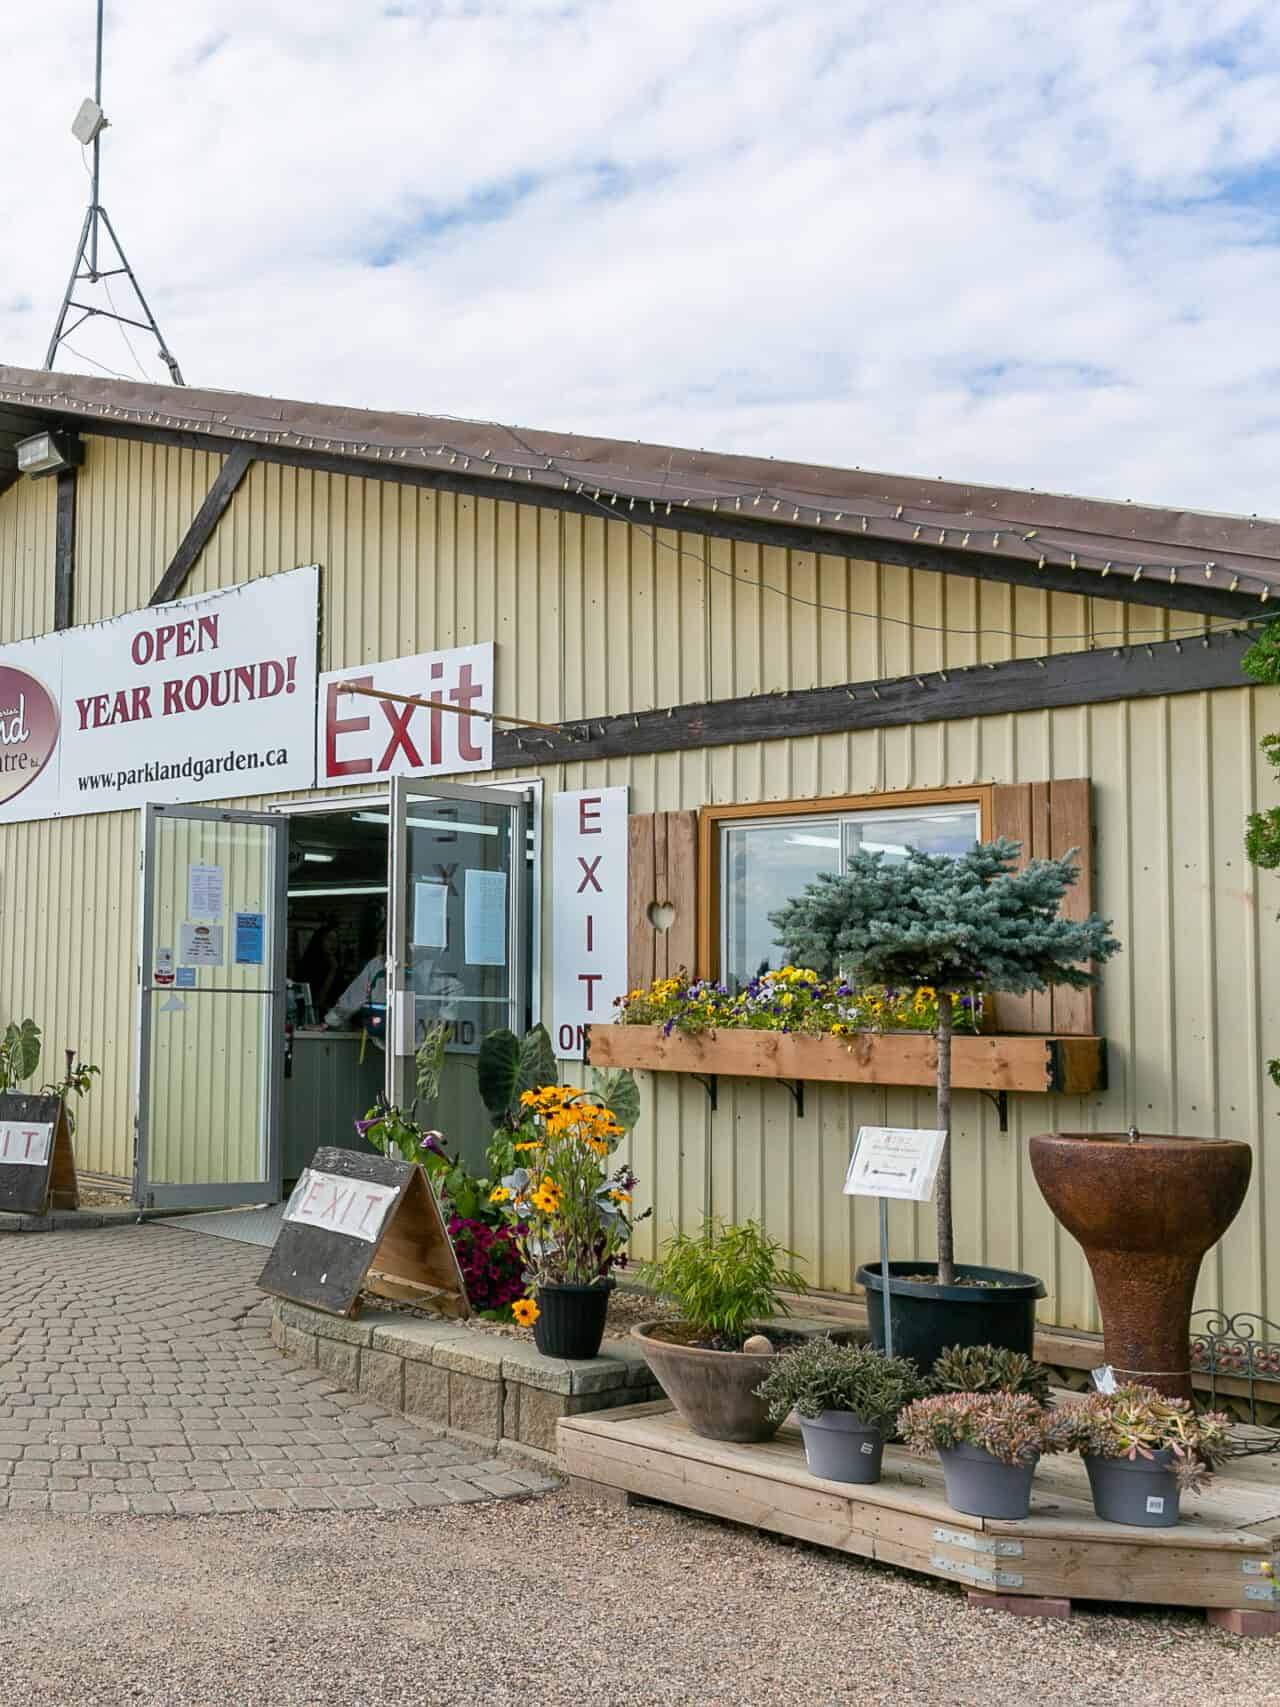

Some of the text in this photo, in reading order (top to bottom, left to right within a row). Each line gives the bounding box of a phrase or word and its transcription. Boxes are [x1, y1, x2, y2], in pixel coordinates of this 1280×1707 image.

[131, 613, 219, 666] OPEN
[75, 655, 297, 731] YEAR ROUND!
[326, 662, 482, 778] Exit
[78, 748, 288, 791] www.parklandgarden.ca
[577, 797, 603, 1011] EXIT
[559, 1024, 585, 1051] ON
[301, 1182, 384, 1229] EXIT
